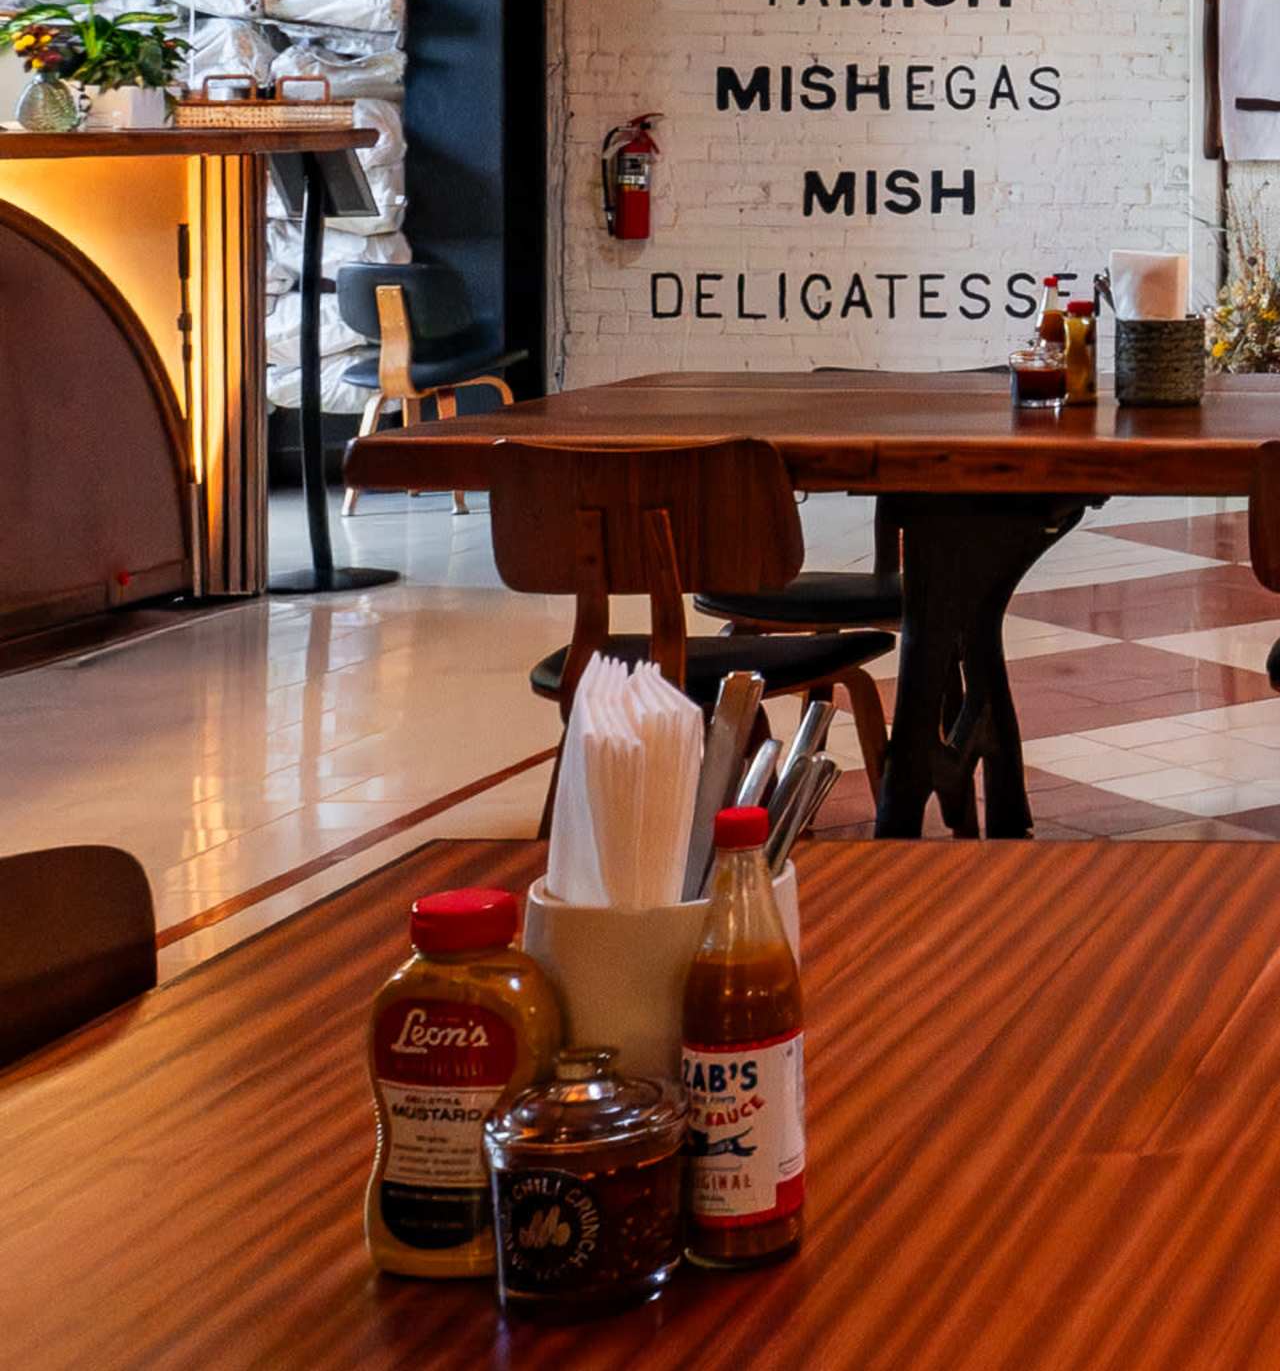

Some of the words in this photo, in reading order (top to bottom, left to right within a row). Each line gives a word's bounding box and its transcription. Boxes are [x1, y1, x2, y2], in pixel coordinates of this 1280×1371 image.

[716, 64, 1061, 112] MISHEGAS
[803, 170, 976, 217] MISH
[390, 1008, 489, 1054] Leon's
[391, 1104, 484, 1123] MUSTARD
[704, 1094, 766, 1128] SAUCE
[512, 1177, 561, 1201] CHILI
[565, 1187, 600, 1269] CRUNCH
